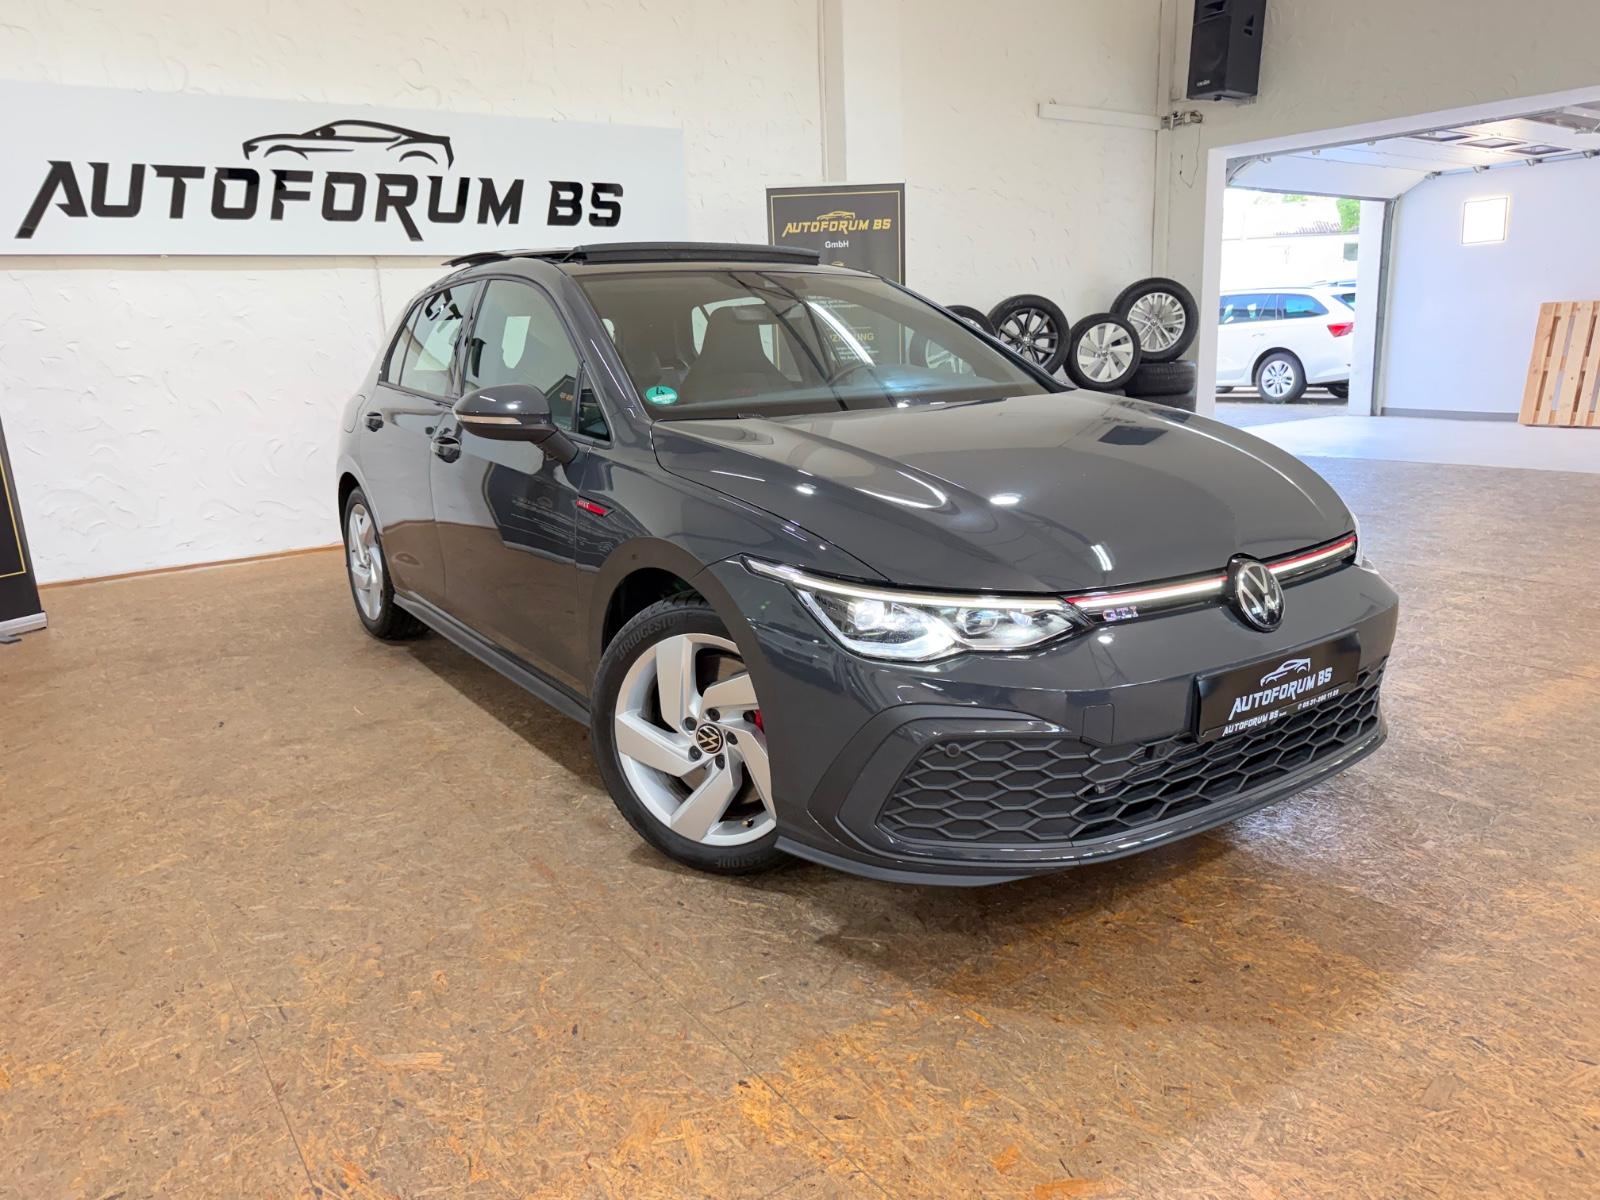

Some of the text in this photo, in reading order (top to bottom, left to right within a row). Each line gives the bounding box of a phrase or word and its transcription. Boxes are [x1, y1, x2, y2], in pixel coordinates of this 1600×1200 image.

[14, 160, 623, 241] AUTOFORUM BS
[782, 219, 891, 237] AUTOFORUM BS
[824, 240, 849, 249] GmbH
[1228, 667, 1332, 721] AUTOFORUM BS
[1222, 713, 1269, 737] AUTOFORUM
